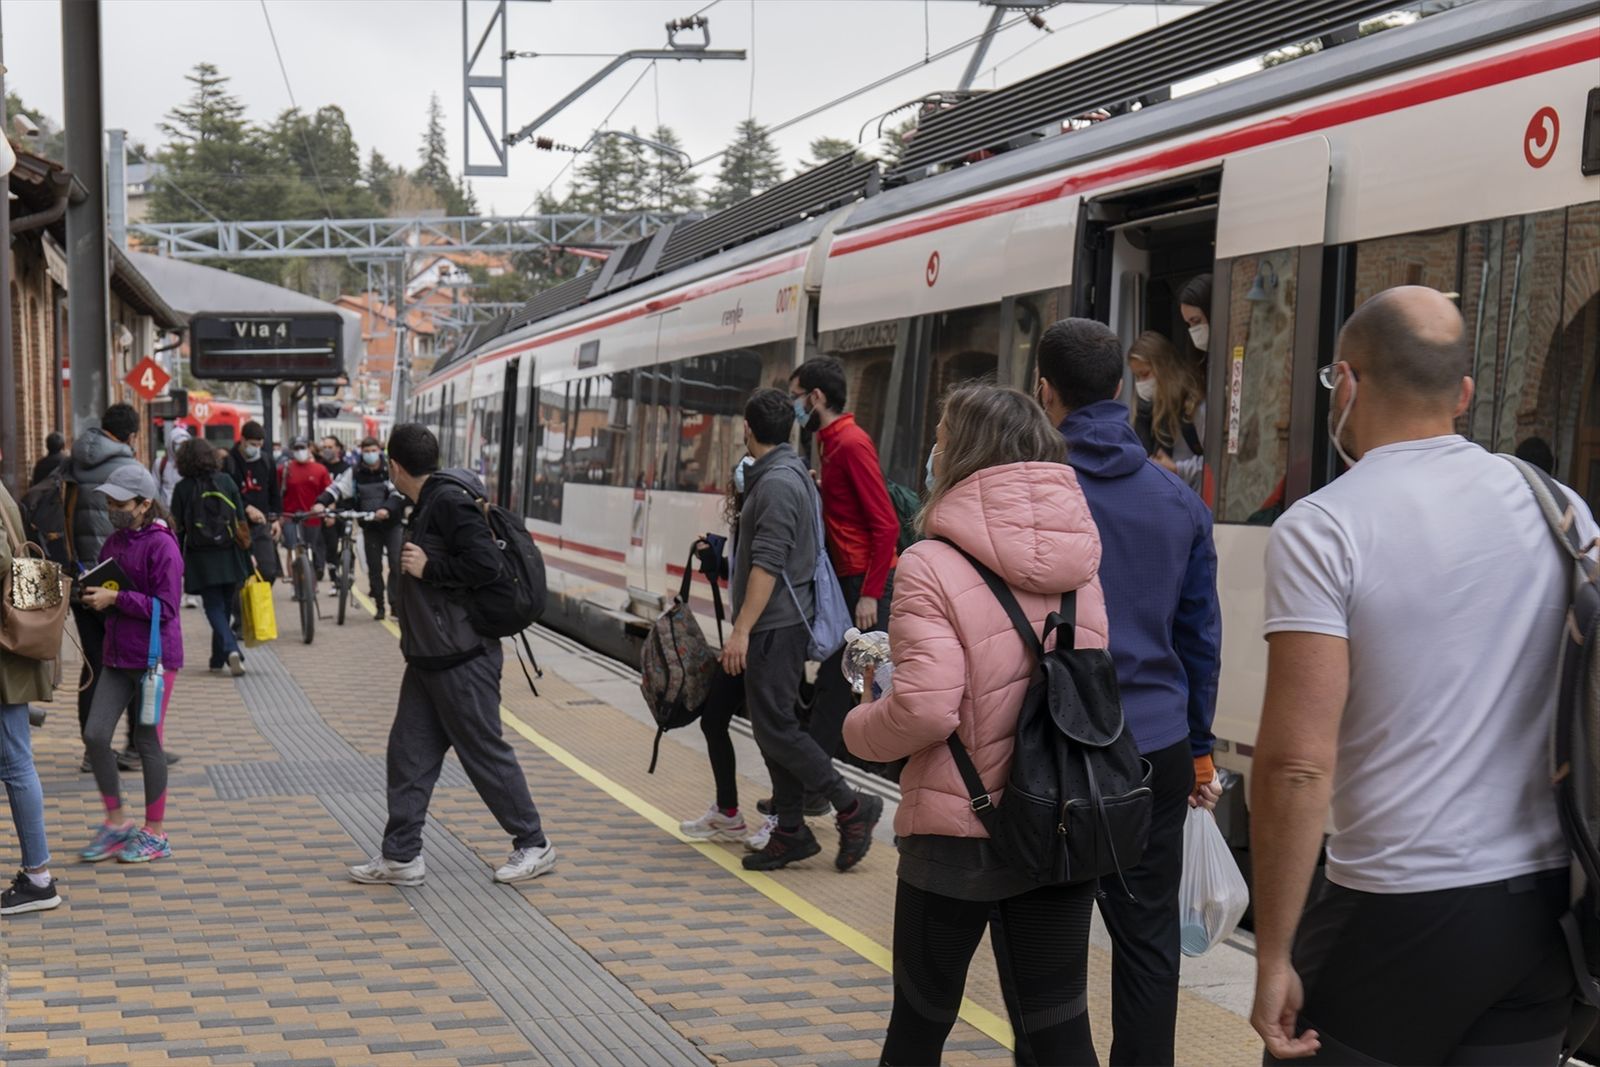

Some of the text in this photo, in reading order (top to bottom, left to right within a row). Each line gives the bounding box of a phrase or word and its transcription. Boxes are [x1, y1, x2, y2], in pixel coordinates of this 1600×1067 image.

[721, 297, 743, 335] renfe
[235, 322, 287, 337] Via 4
[140, 367, 156, 391] 4
[194, 402, 209, 417] 01
